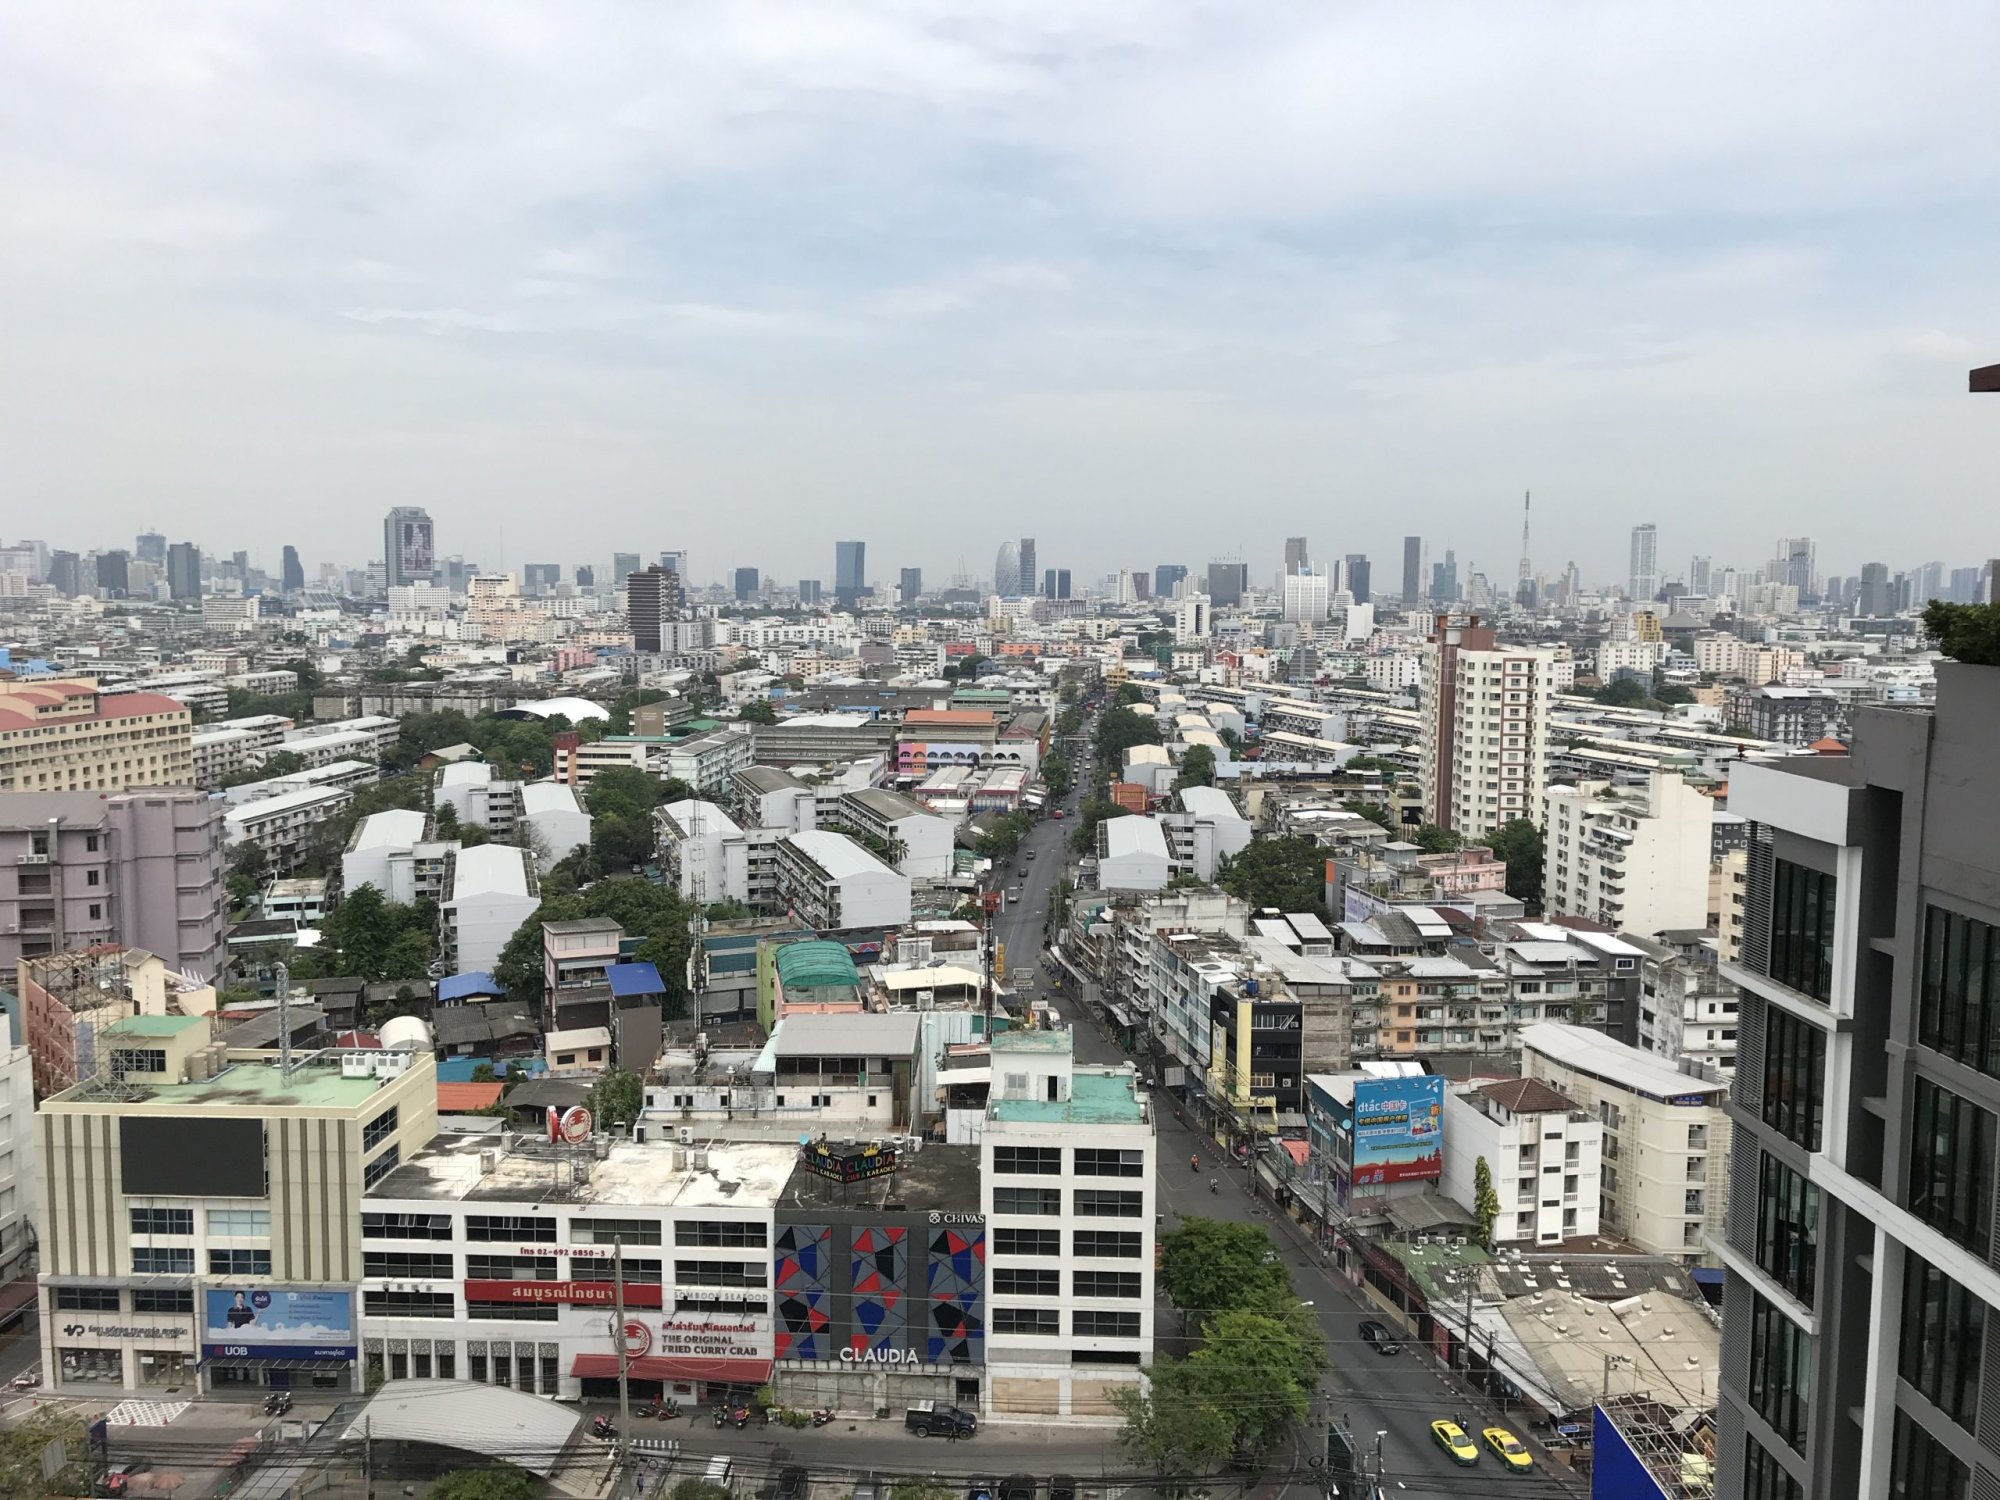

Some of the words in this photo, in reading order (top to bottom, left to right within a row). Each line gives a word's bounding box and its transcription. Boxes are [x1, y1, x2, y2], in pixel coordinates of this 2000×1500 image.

[846, 1154, 895, 1173] CLAUDIA
[866, 1166, 896, 1177] KARAOKE
[944, 1214, 985, 1224] CHIVAS
[537, 1248, 569, 1256] 02-692
[662, 1335, 682, 1344] THE
[683, 1335, 734, 1345] ORIGINAL
[225, 1346, 248, 1356] UOB
[662, 1345, 691, 1354] FRIED
[693, 1346, 728, 1355] CURRY
[729, 1346, 758, 1356] CRAB
